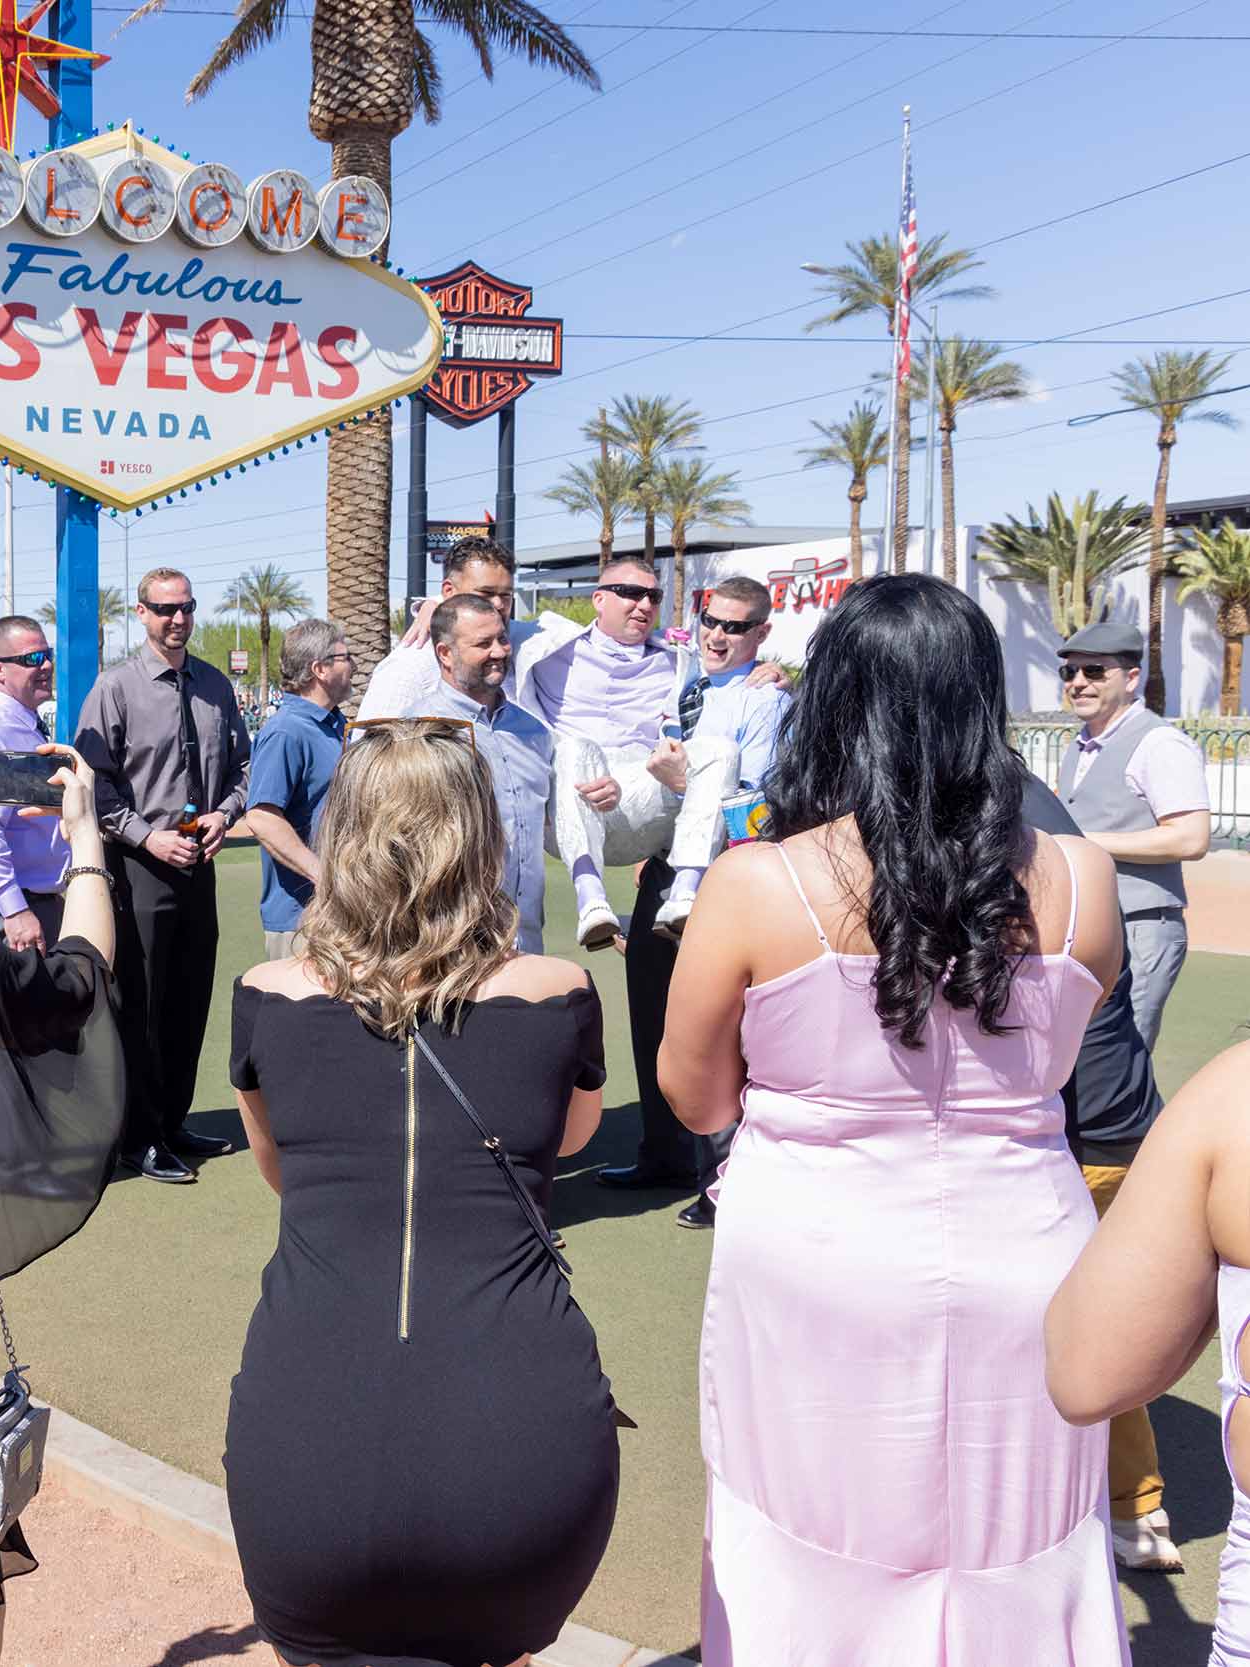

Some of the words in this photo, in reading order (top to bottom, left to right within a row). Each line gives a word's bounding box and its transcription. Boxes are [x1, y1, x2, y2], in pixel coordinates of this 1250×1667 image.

[1, 242, 303, 306] Fabulous
[74, 307, 361, 400] VEGAS
[26, 405, 212, 441] NEVADA
[119, 463, 152, 474] YESCO
